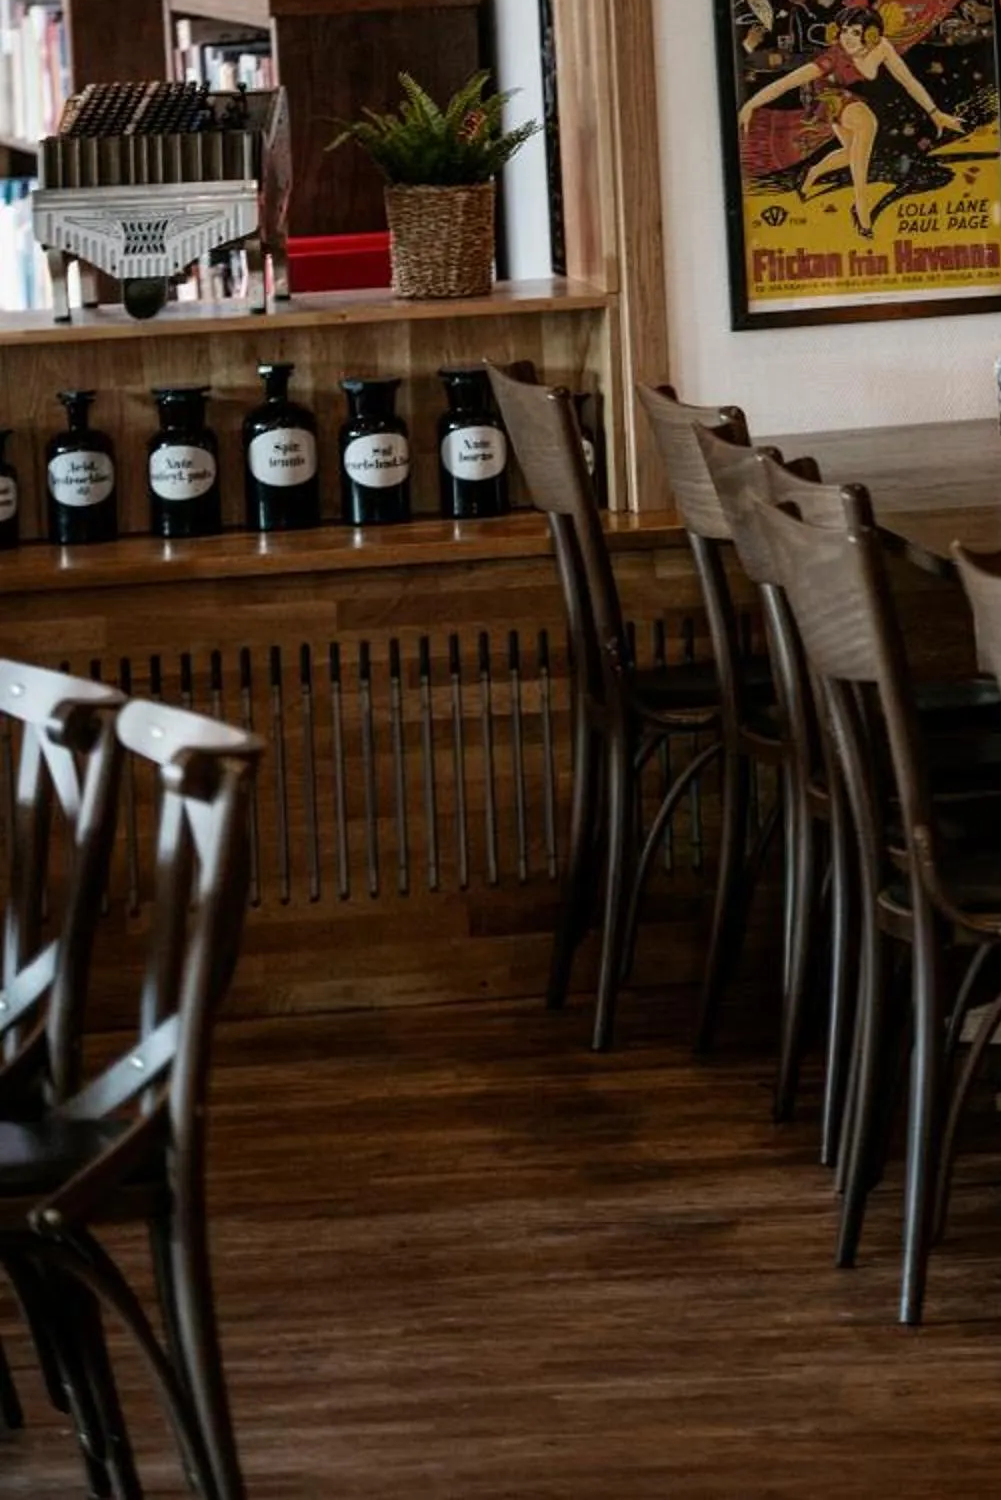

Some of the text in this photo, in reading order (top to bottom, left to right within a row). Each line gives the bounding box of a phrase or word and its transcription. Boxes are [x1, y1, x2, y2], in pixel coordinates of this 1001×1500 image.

[896, 197, 990, 218] LOLA LANE
[897, 214, 990, 234] PAUL PAGE
[752, 247, 843, 282] Flickan
[893, 239, 1001, 274] Havanna
